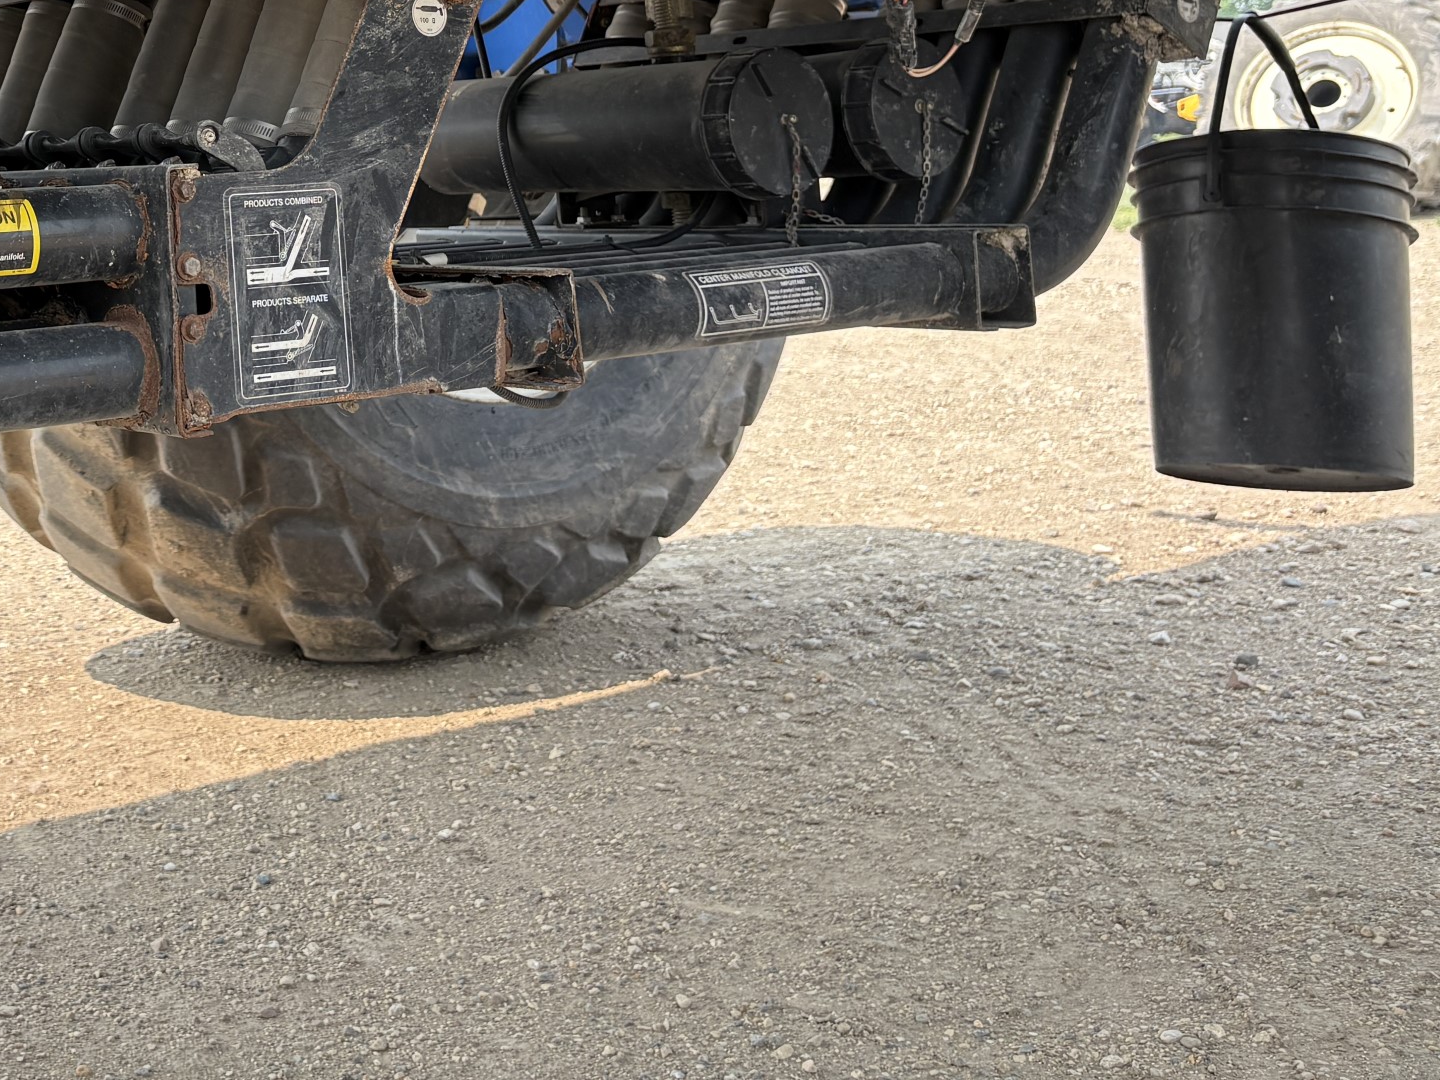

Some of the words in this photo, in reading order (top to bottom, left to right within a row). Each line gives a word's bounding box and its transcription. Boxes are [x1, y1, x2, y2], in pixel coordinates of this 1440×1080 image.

[244, 198, 283, 208] PRODUCTS
[284, 196, 323, 205] COMBINED
[698, 273, 731, 284] CENTER
[732, 269, 772, 281] MANIFOLD
[772, 265, 812, 277] CLEANOUT
[252, 297, 292, 308] PRODUCTS
[293, 294, 329, 305] SEPARATE
